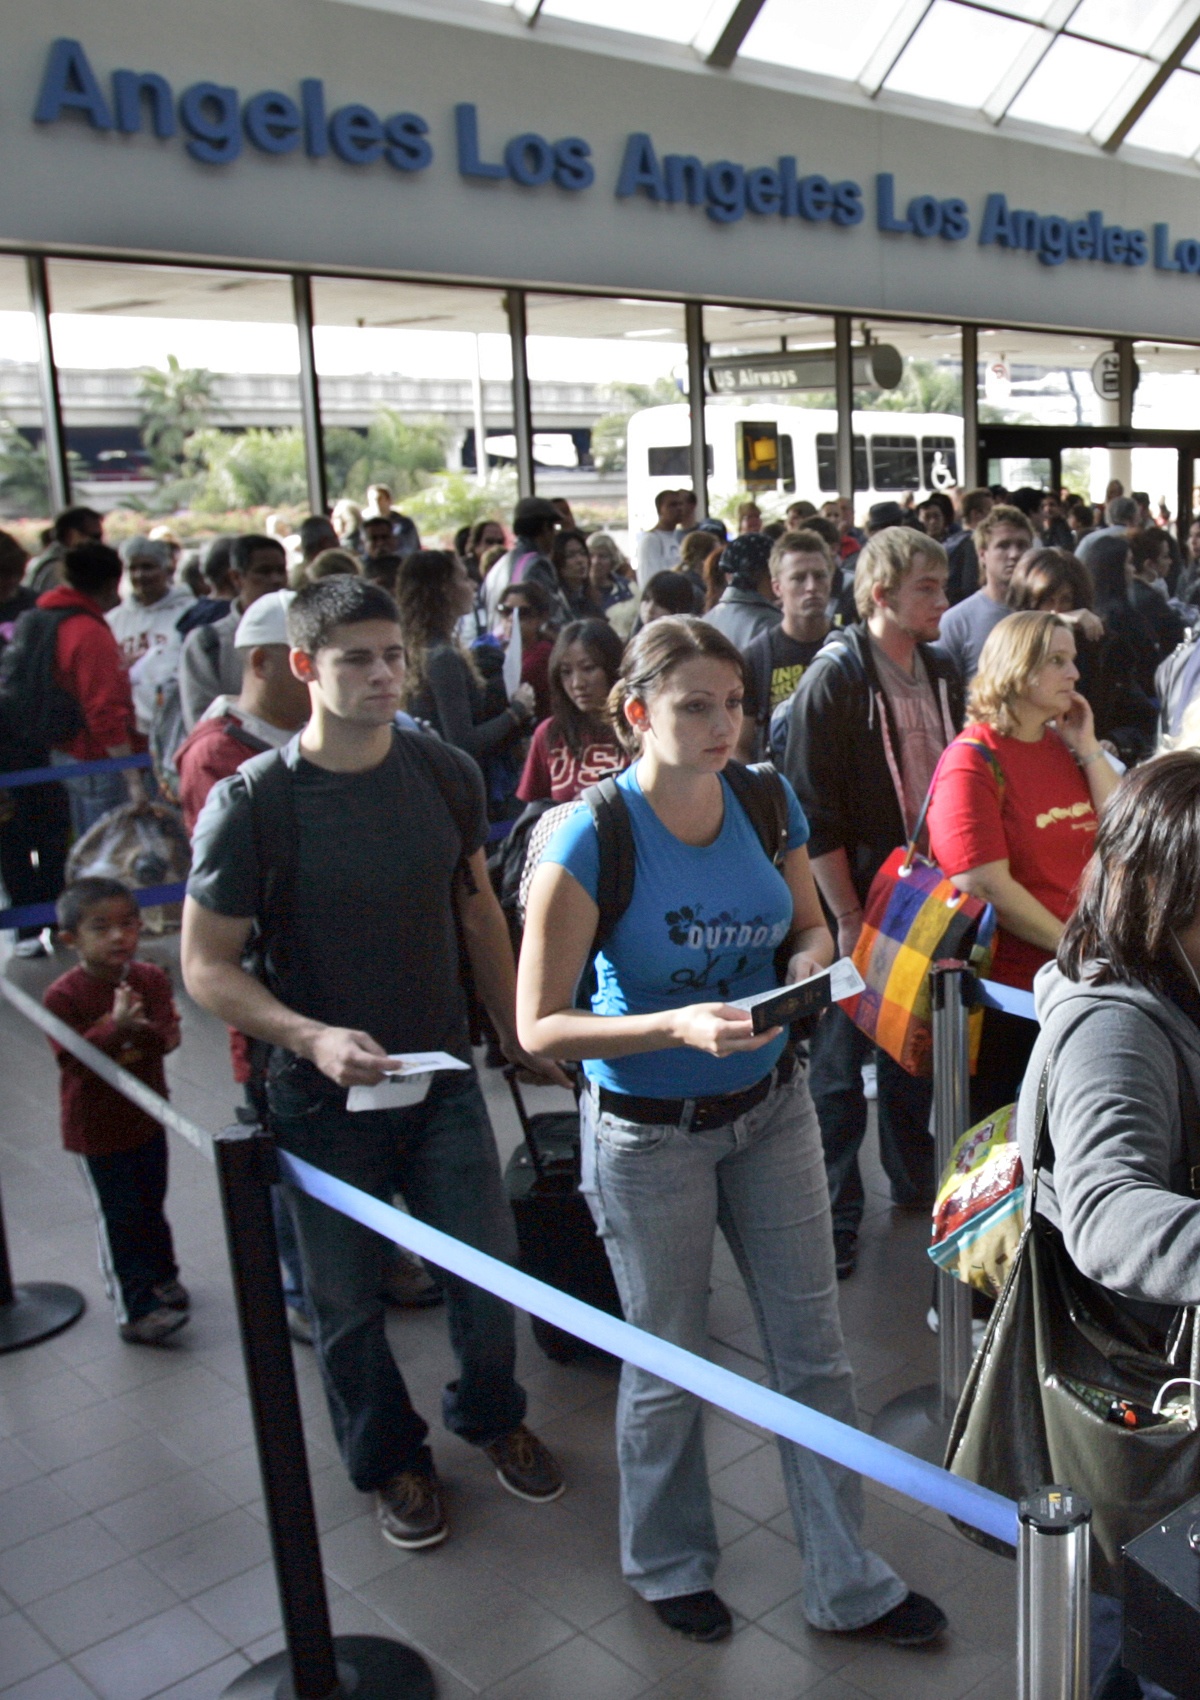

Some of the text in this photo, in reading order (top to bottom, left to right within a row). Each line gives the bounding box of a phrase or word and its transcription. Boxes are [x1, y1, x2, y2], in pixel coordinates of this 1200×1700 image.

[33, 37, 433, 166] Angeles
[455, 102, 595, 190] Los
[616, 132, 864, 226] Angeles
[876, 173, 970, 240] Los
[979, 193, 1148, 267] Angeles
[714, 368, 798, 388] US Airways
